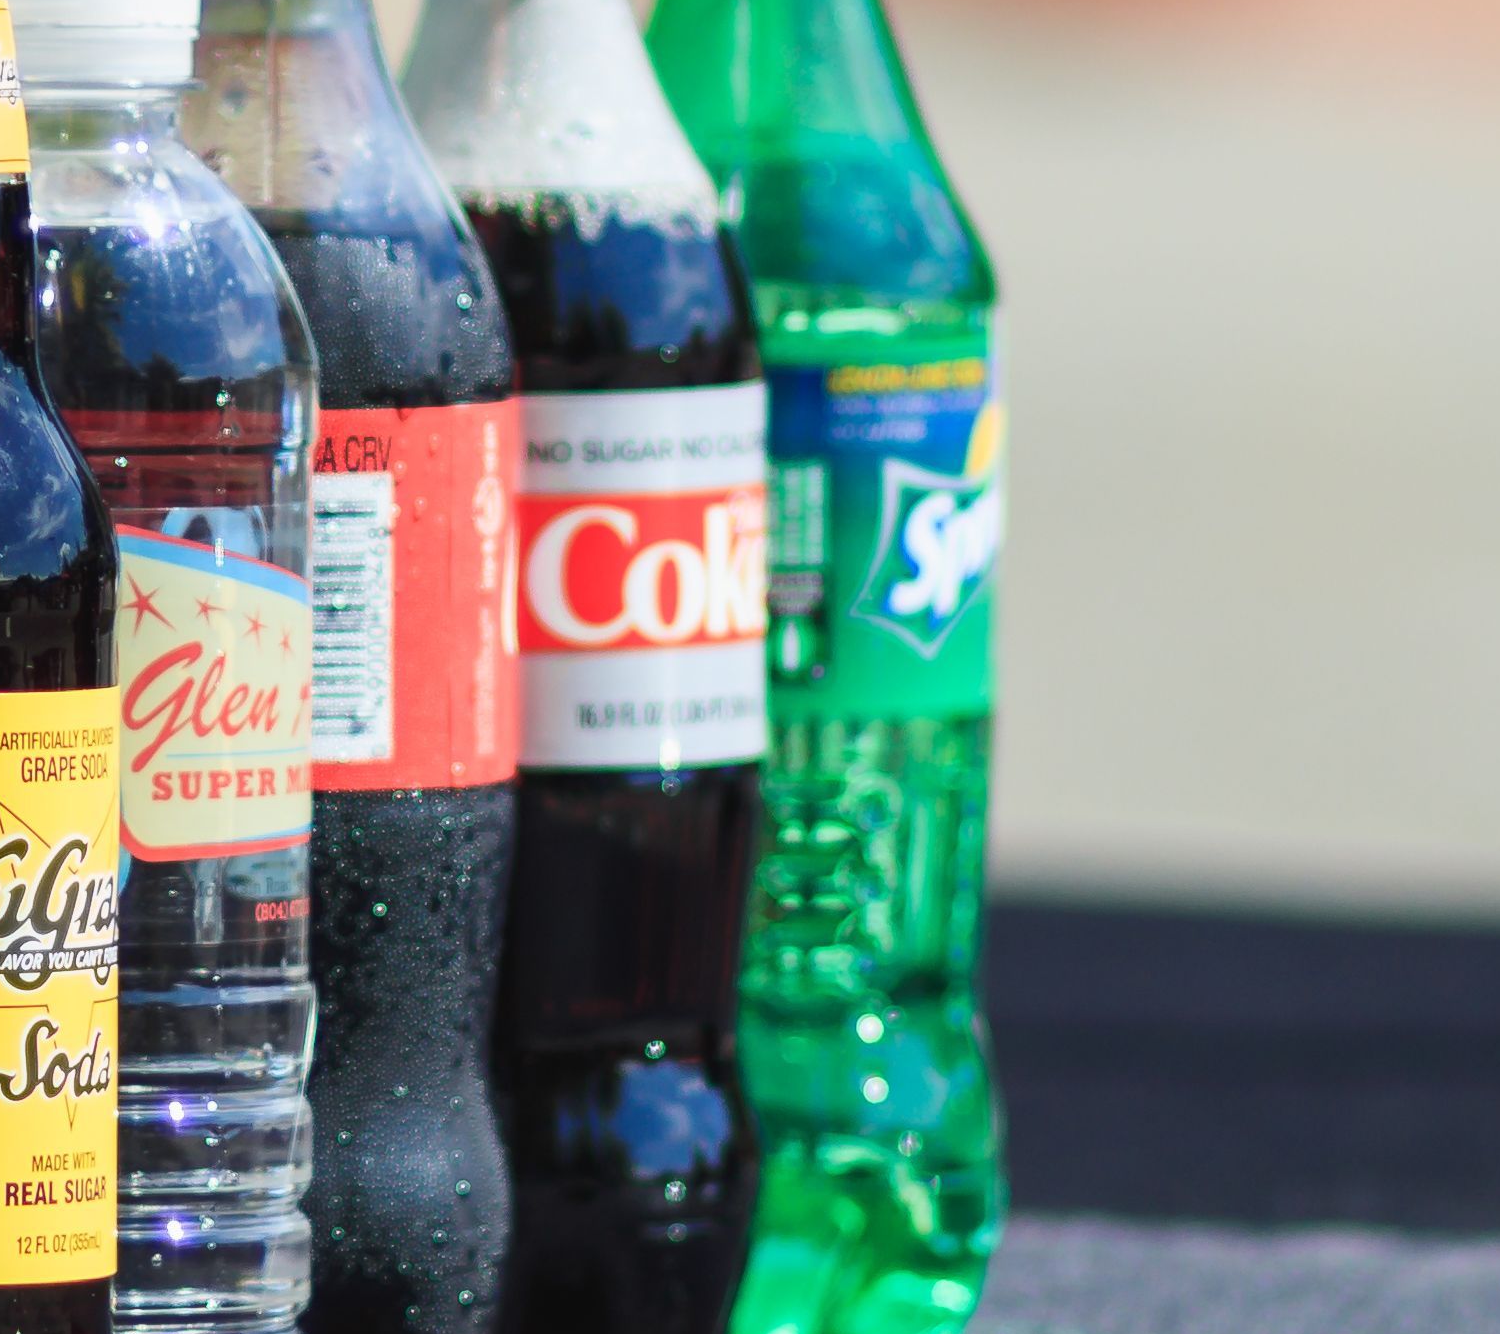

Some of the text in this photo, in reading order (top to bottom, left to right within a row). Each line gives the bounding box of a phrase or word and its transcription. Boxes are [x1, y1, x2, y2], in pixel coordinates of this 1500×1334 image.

[345, 434, 392, 473] CRV
[527, 440, 573, 464] NO
[582, 436, 674, 463] SUGAR
[680, 433, 713, 460] NO
[122, 641, 279, 773] Glen
[0, 729, 79, 751] ARTIFICIALLY
[20, 750, 109, 784] GRAPE SODA
[151, 767, 278, 802] SUPER
[48, 951, 74, 970] YOU
[31, 1150, 97, 1173] MADE WITH
[5, 1175, 108, 1207] REAL SUGAR
[16, 1235, 32, 1255] 12
[36, 1234, 50, 1254] FL
[53, 1233, 67, 1253] OZ
